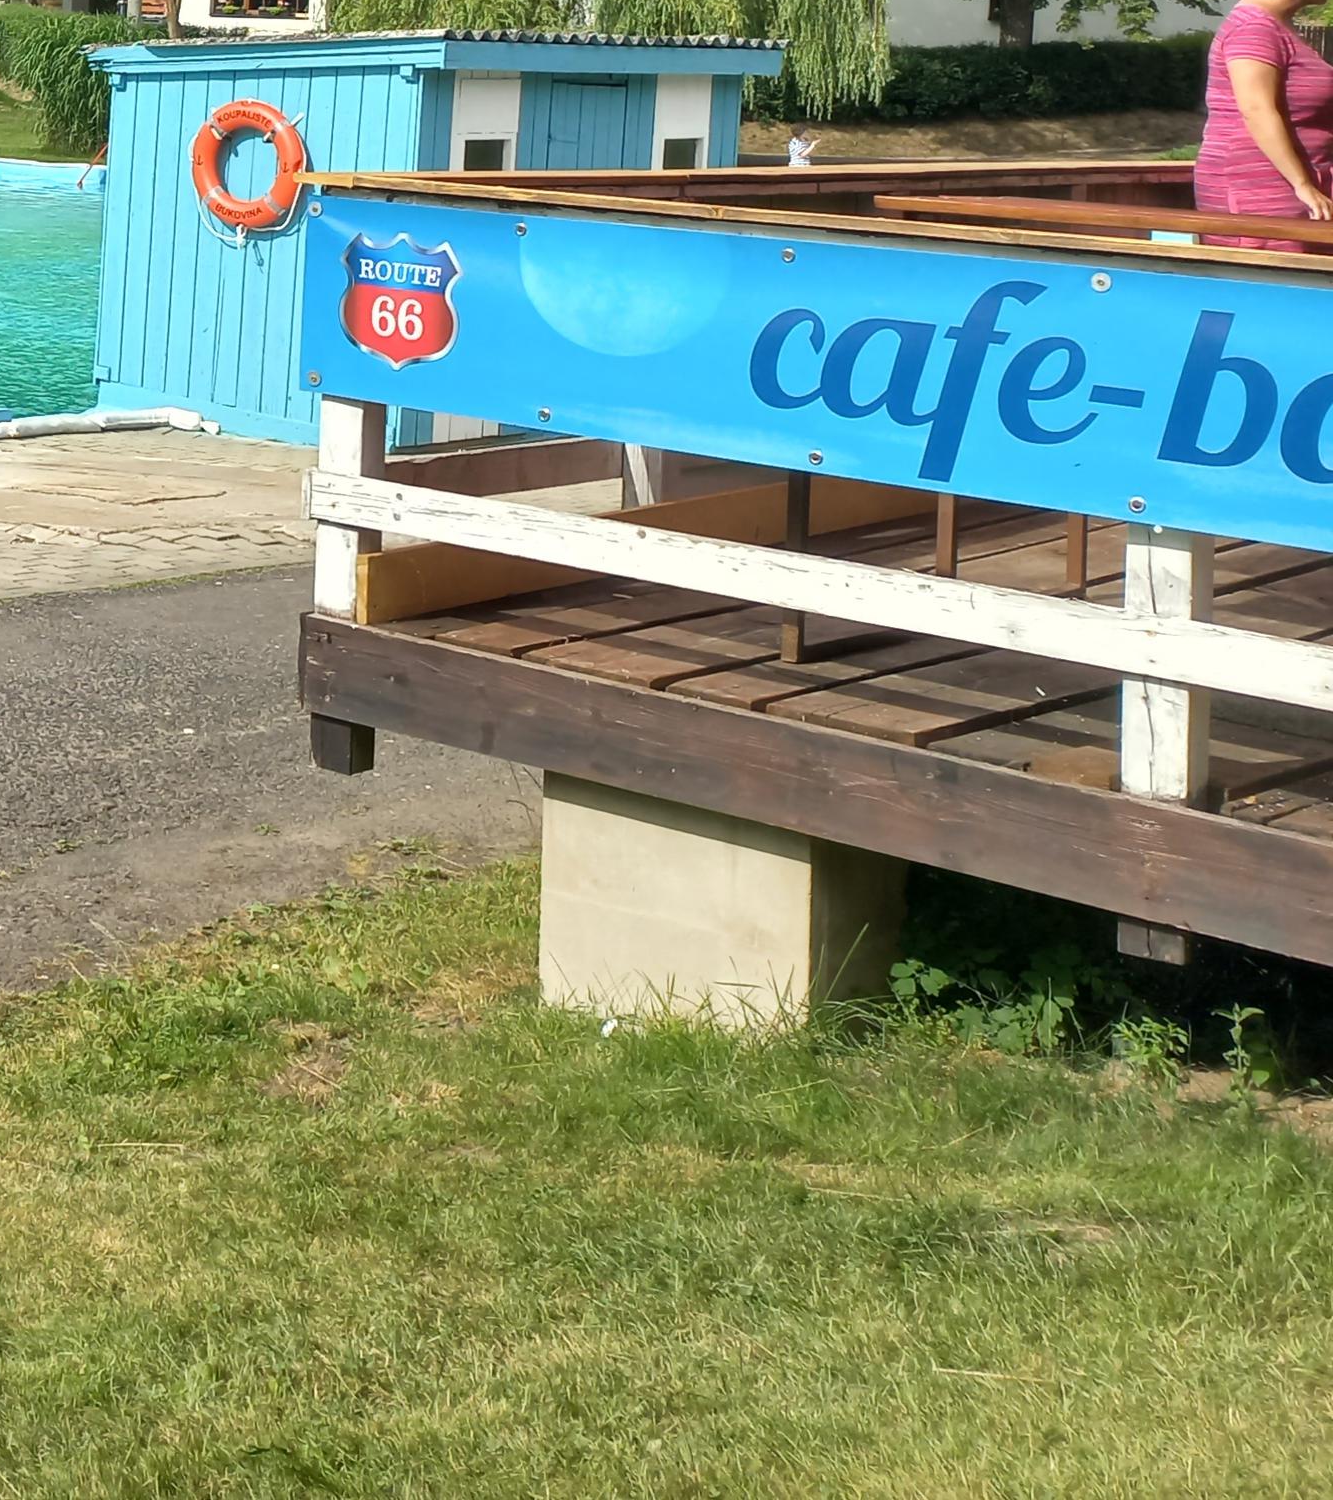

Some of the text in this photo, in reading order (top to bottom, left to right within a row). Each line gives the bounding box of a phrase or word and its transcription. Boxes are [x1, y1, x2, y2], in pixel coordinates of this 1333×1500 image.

[215, 203, 263, 219] BUKOVINA
[359, 258, 441, 287] ROUTE
[371, 295, 424, 341] 66
